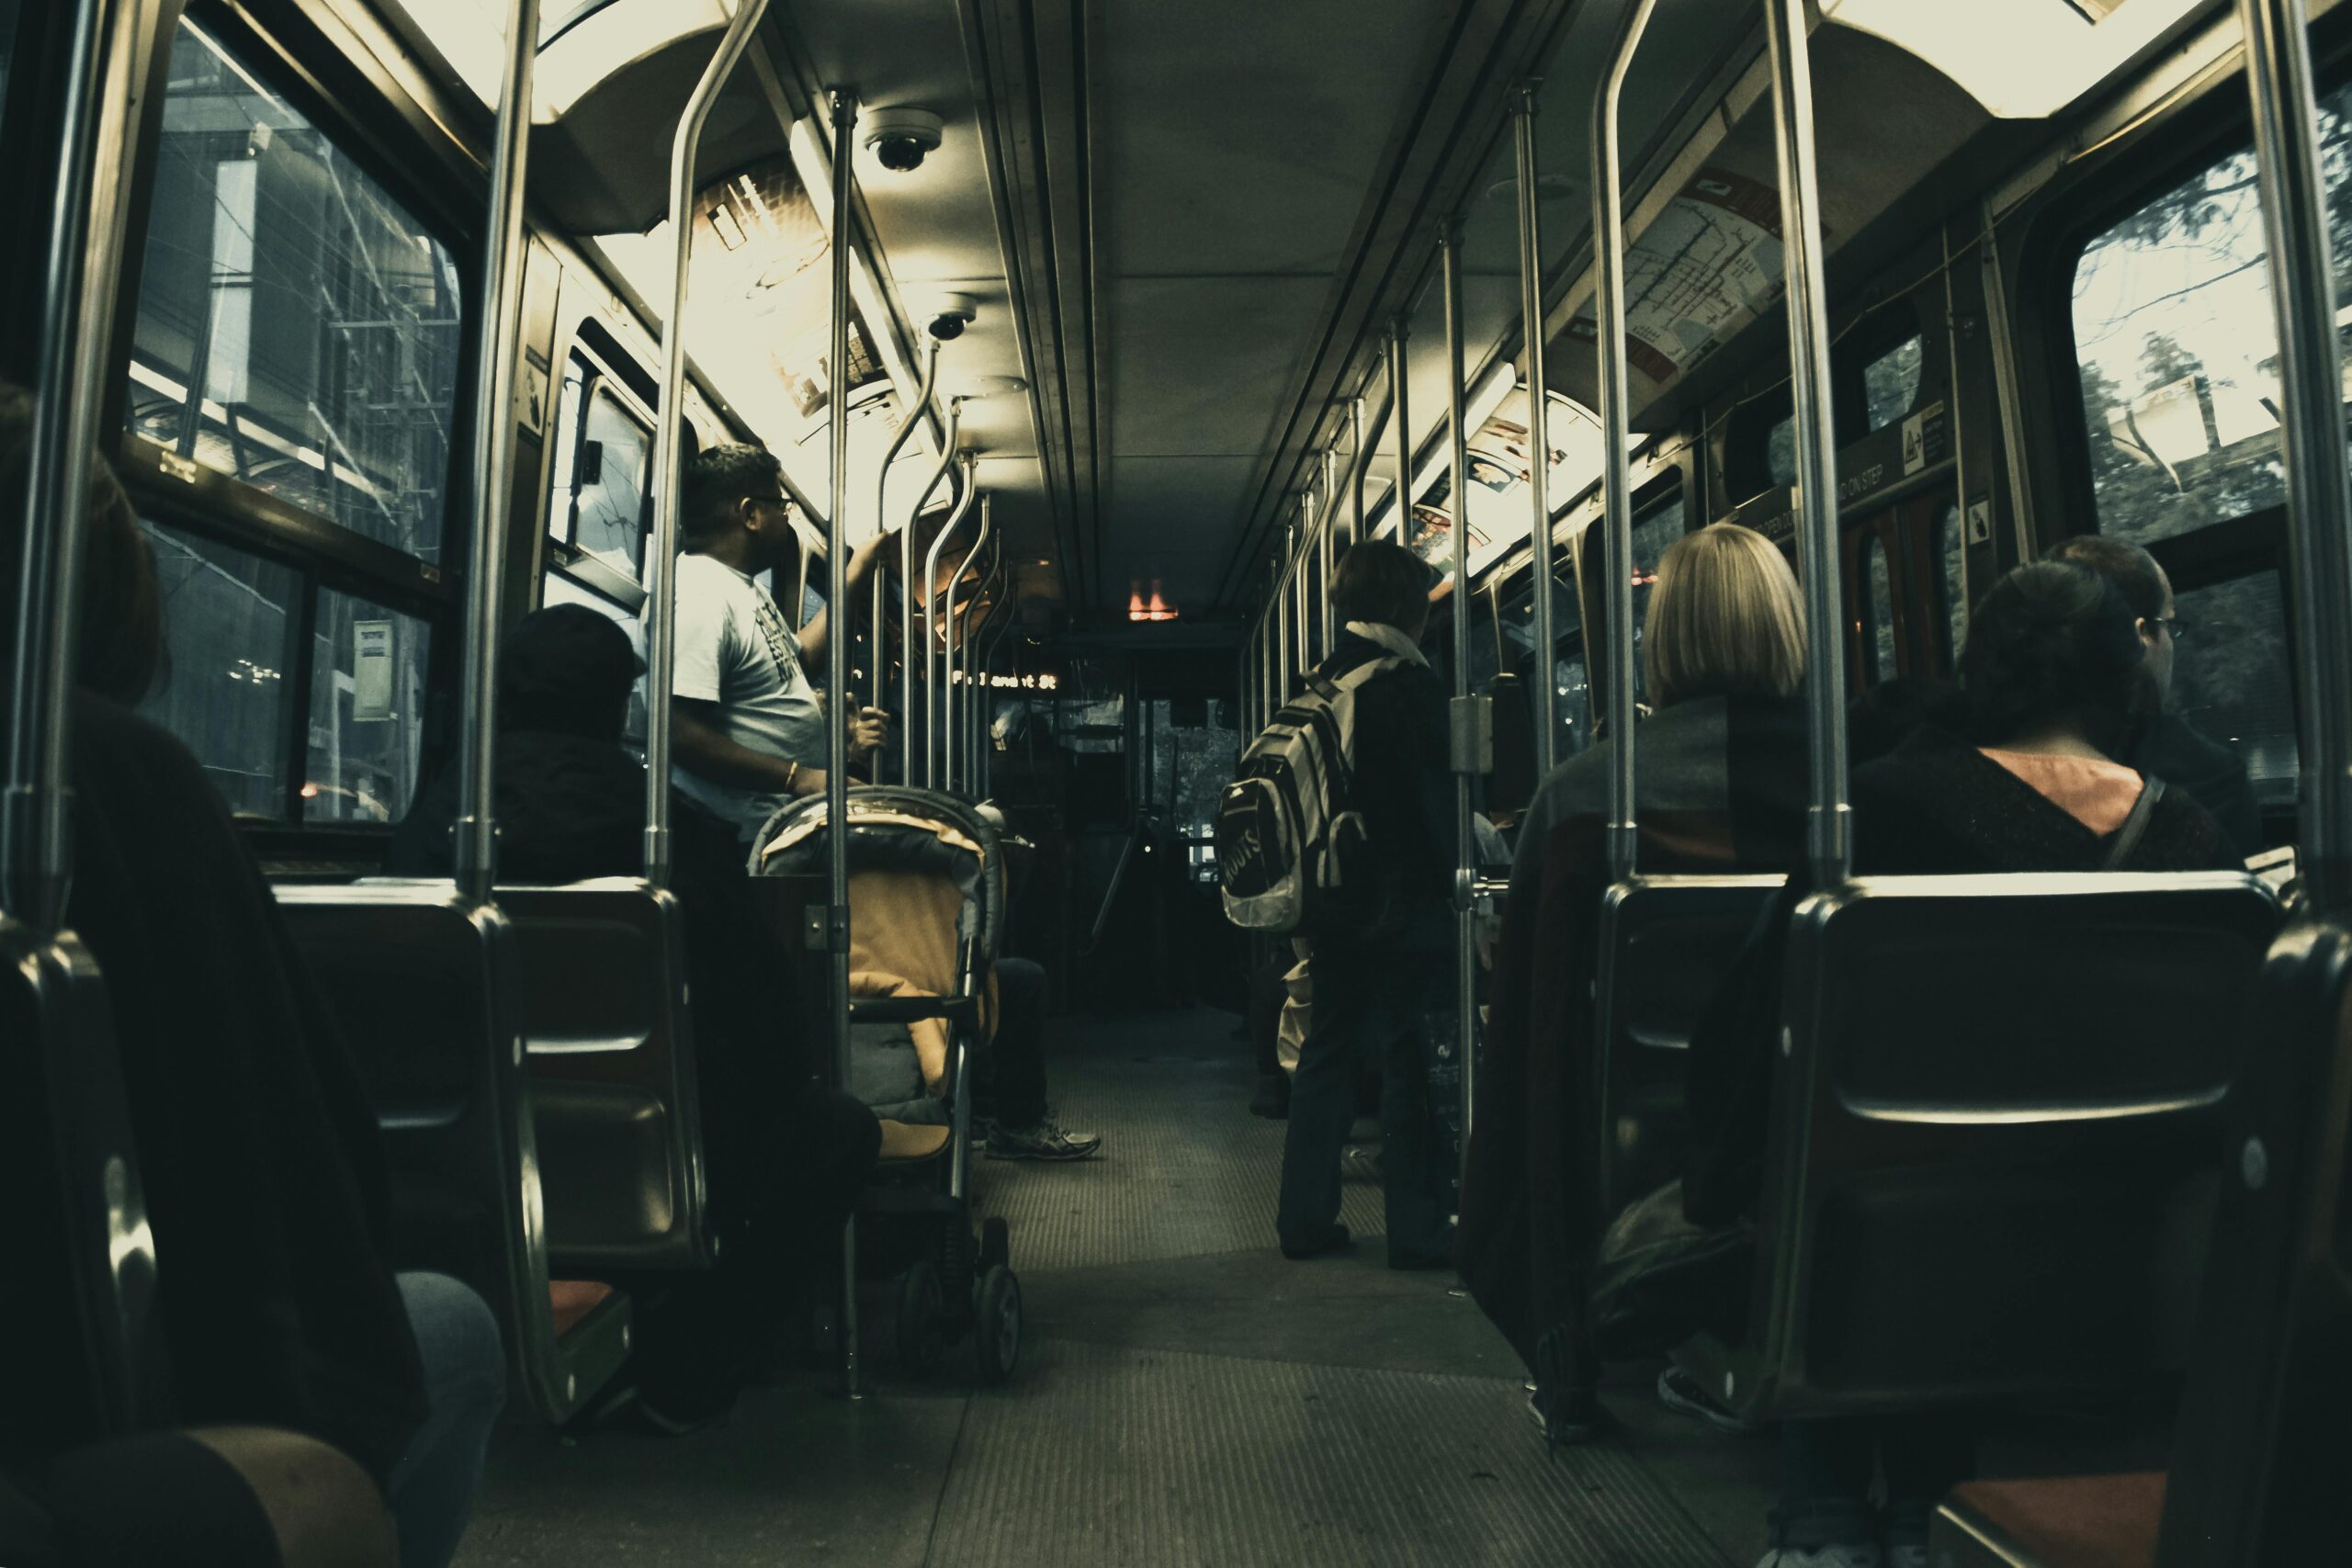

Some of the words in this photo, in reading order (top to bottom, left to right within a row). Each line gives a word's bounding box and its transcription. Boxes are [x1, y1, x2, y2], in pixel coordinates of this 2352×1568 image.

[1848, 477, 1861, 497] ON
[1861, 463, 1883, 491] STEP
[1038, 674, 1057, 690] St
